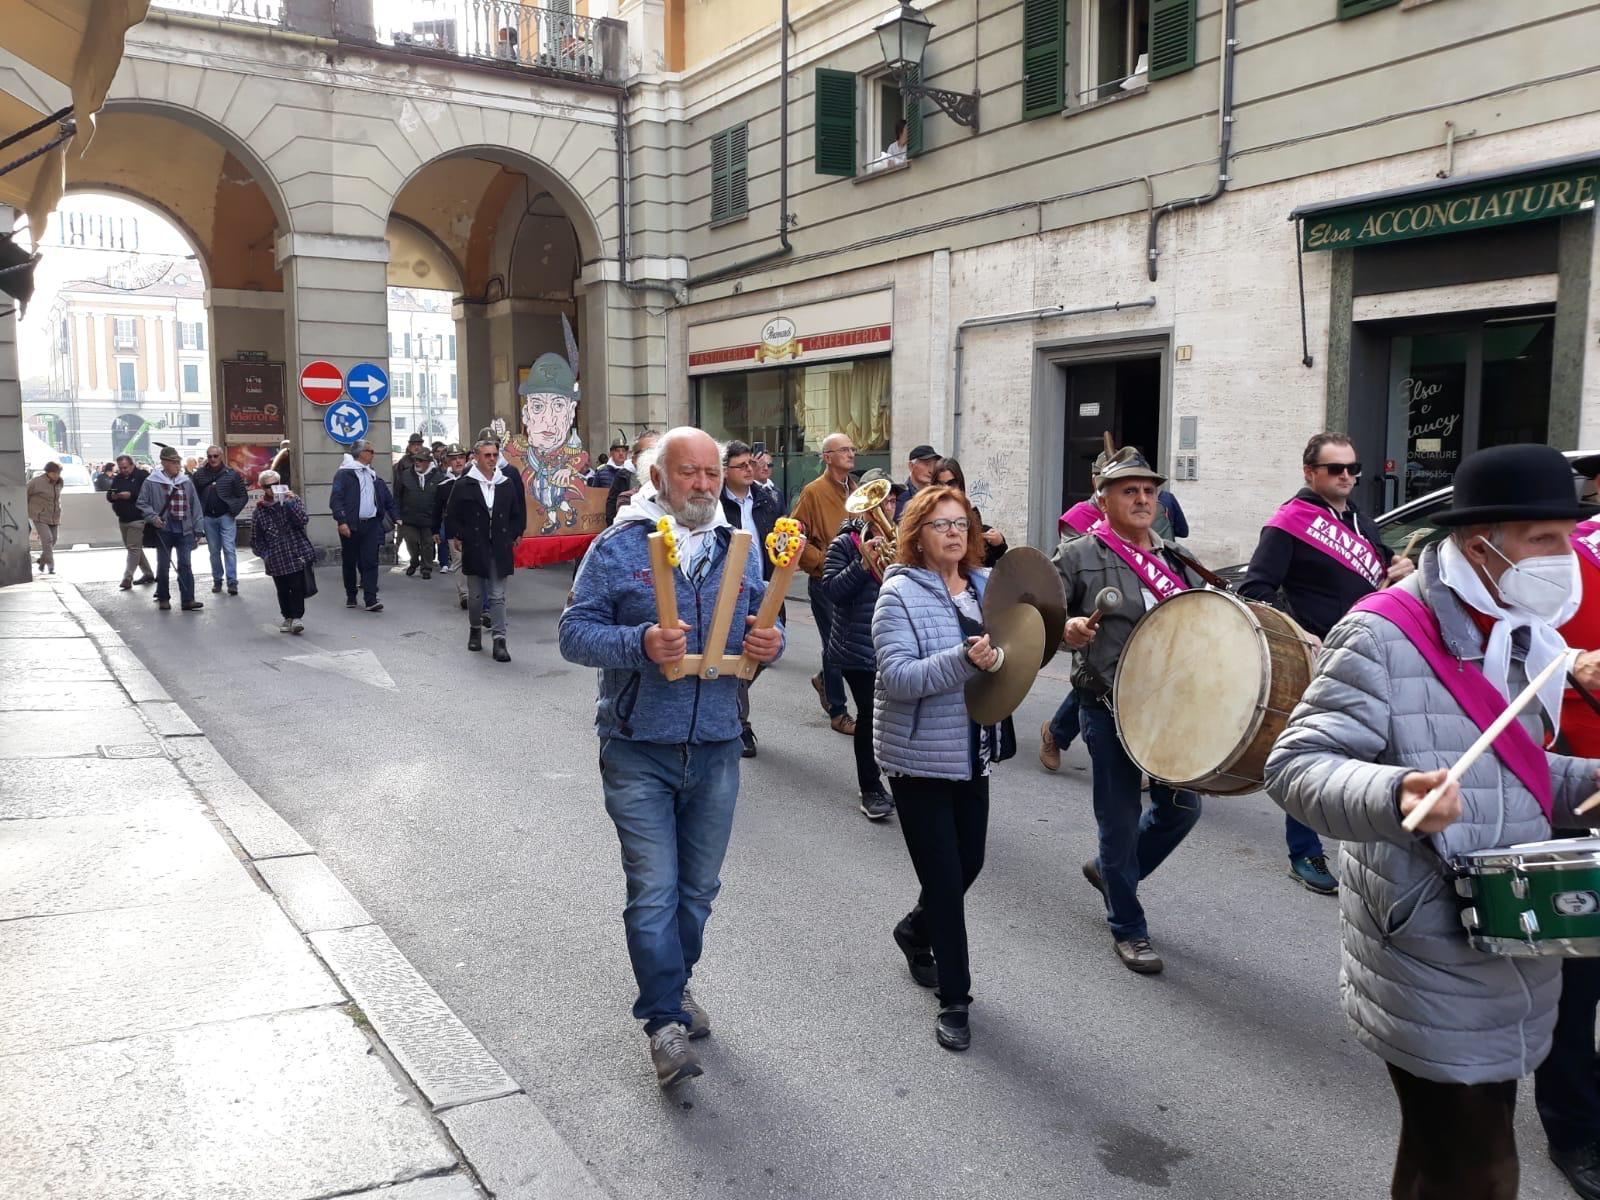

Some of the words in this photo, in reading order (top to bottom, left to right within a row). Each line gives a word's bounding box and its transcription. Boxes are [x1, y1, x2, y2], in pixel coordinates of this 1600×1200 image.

[1308, 223, 1351, 248] Elsa
[1357, 175, 1598, 239] ACCONCIATURE
[809, 328, 882, 349] CAFFETTERIA
[693, 347, 748, 365] PASTICCERIA
[1306, 527, 1352, 560] ERMANNO
